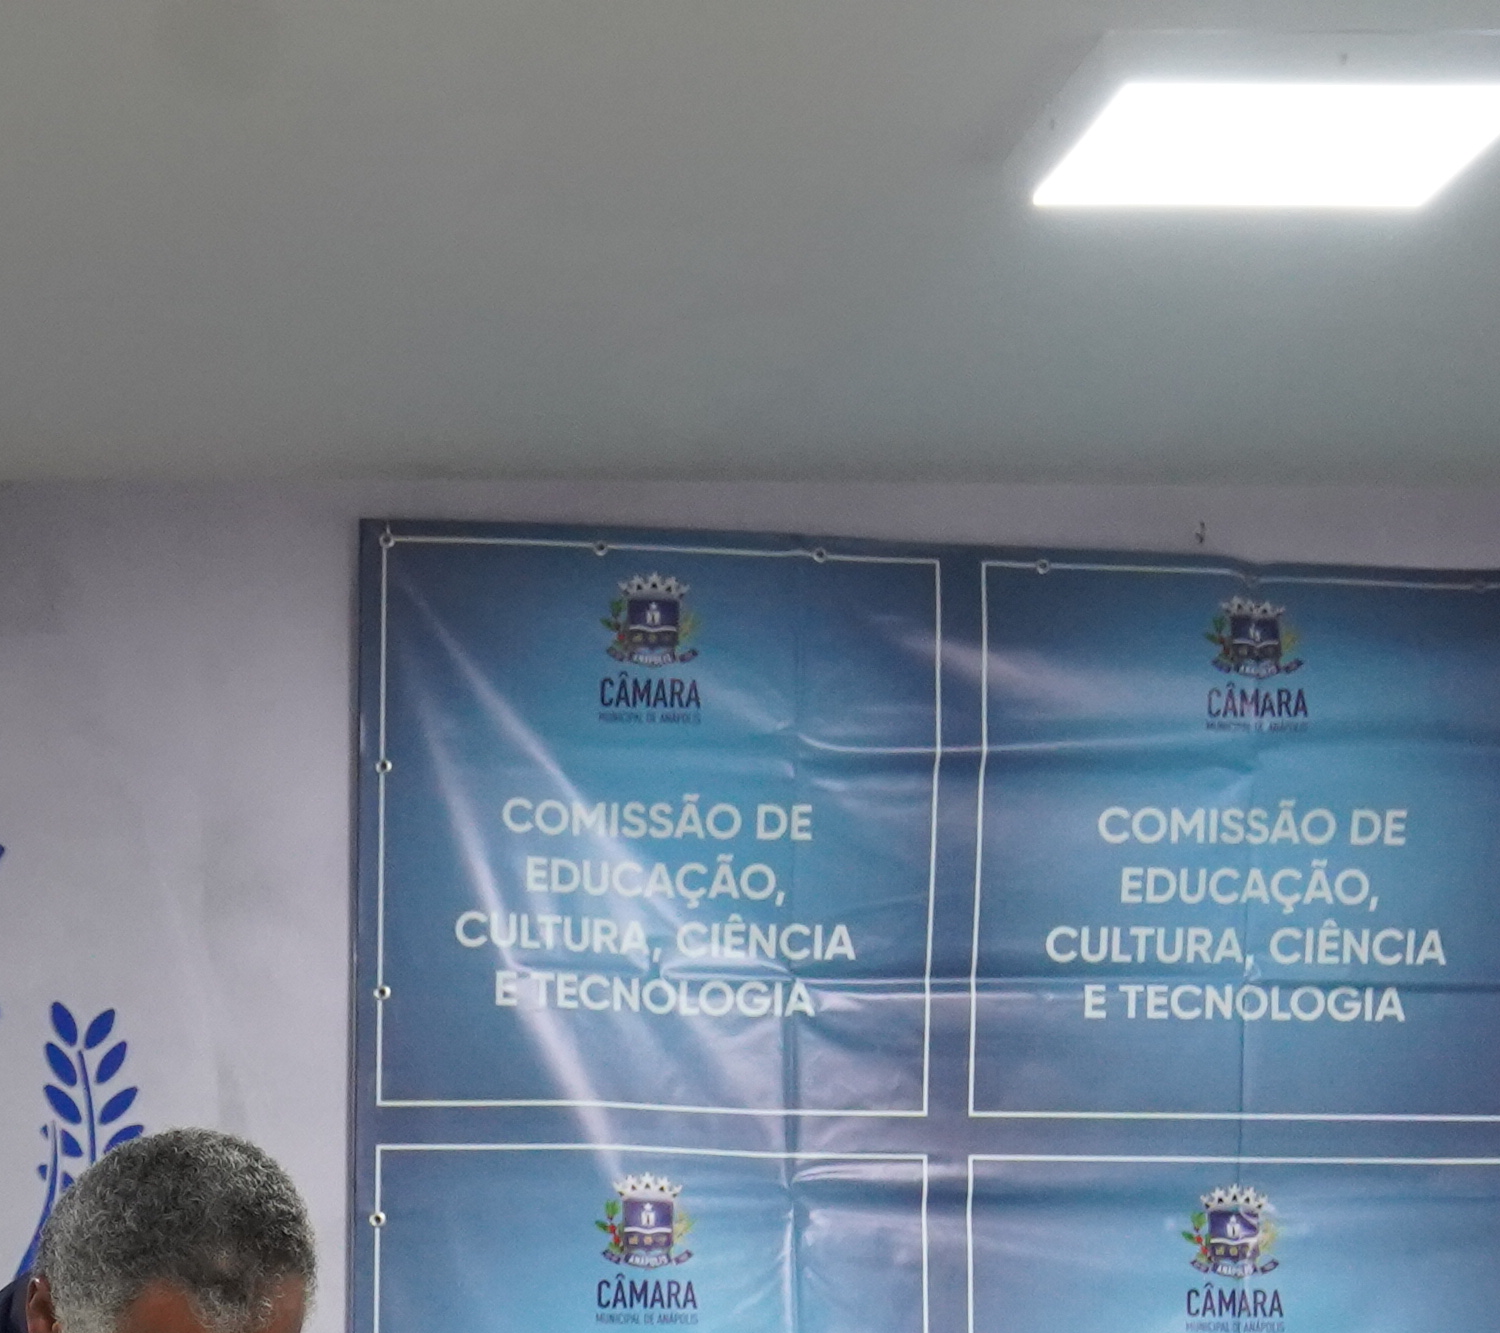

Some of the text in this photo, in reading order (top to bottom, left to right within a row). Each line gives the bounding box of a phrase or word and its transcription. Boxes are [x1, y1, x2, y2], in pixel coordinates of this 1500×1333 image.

[600, 670, 701, 709] CÂMARA
[1207, 680, 1308, 718] CÂMARA
[502, 793, 813, 841] COMISSÃO DE
[1098, 800, 1408, 846] COMISSÃO DE
[525, 854, 786, 908] EDUCAÇÃO,
[1120, 859, 1379, 914] EDUCAÇÃO,
[454, 911, 857, 963] CULTURA, CIÊNCIA
[1045, 918, 1447, 975] CULTURA, CIÊNCIA
[494, 971, 816, 1018] E TECNOLOGIA
[1083, 983, 1406, 1022] E TECNOLOGIA
[596, 1272, 698, 1310] CÂMARA
[1186, 1282, 1284, 1319] CÂMARA
